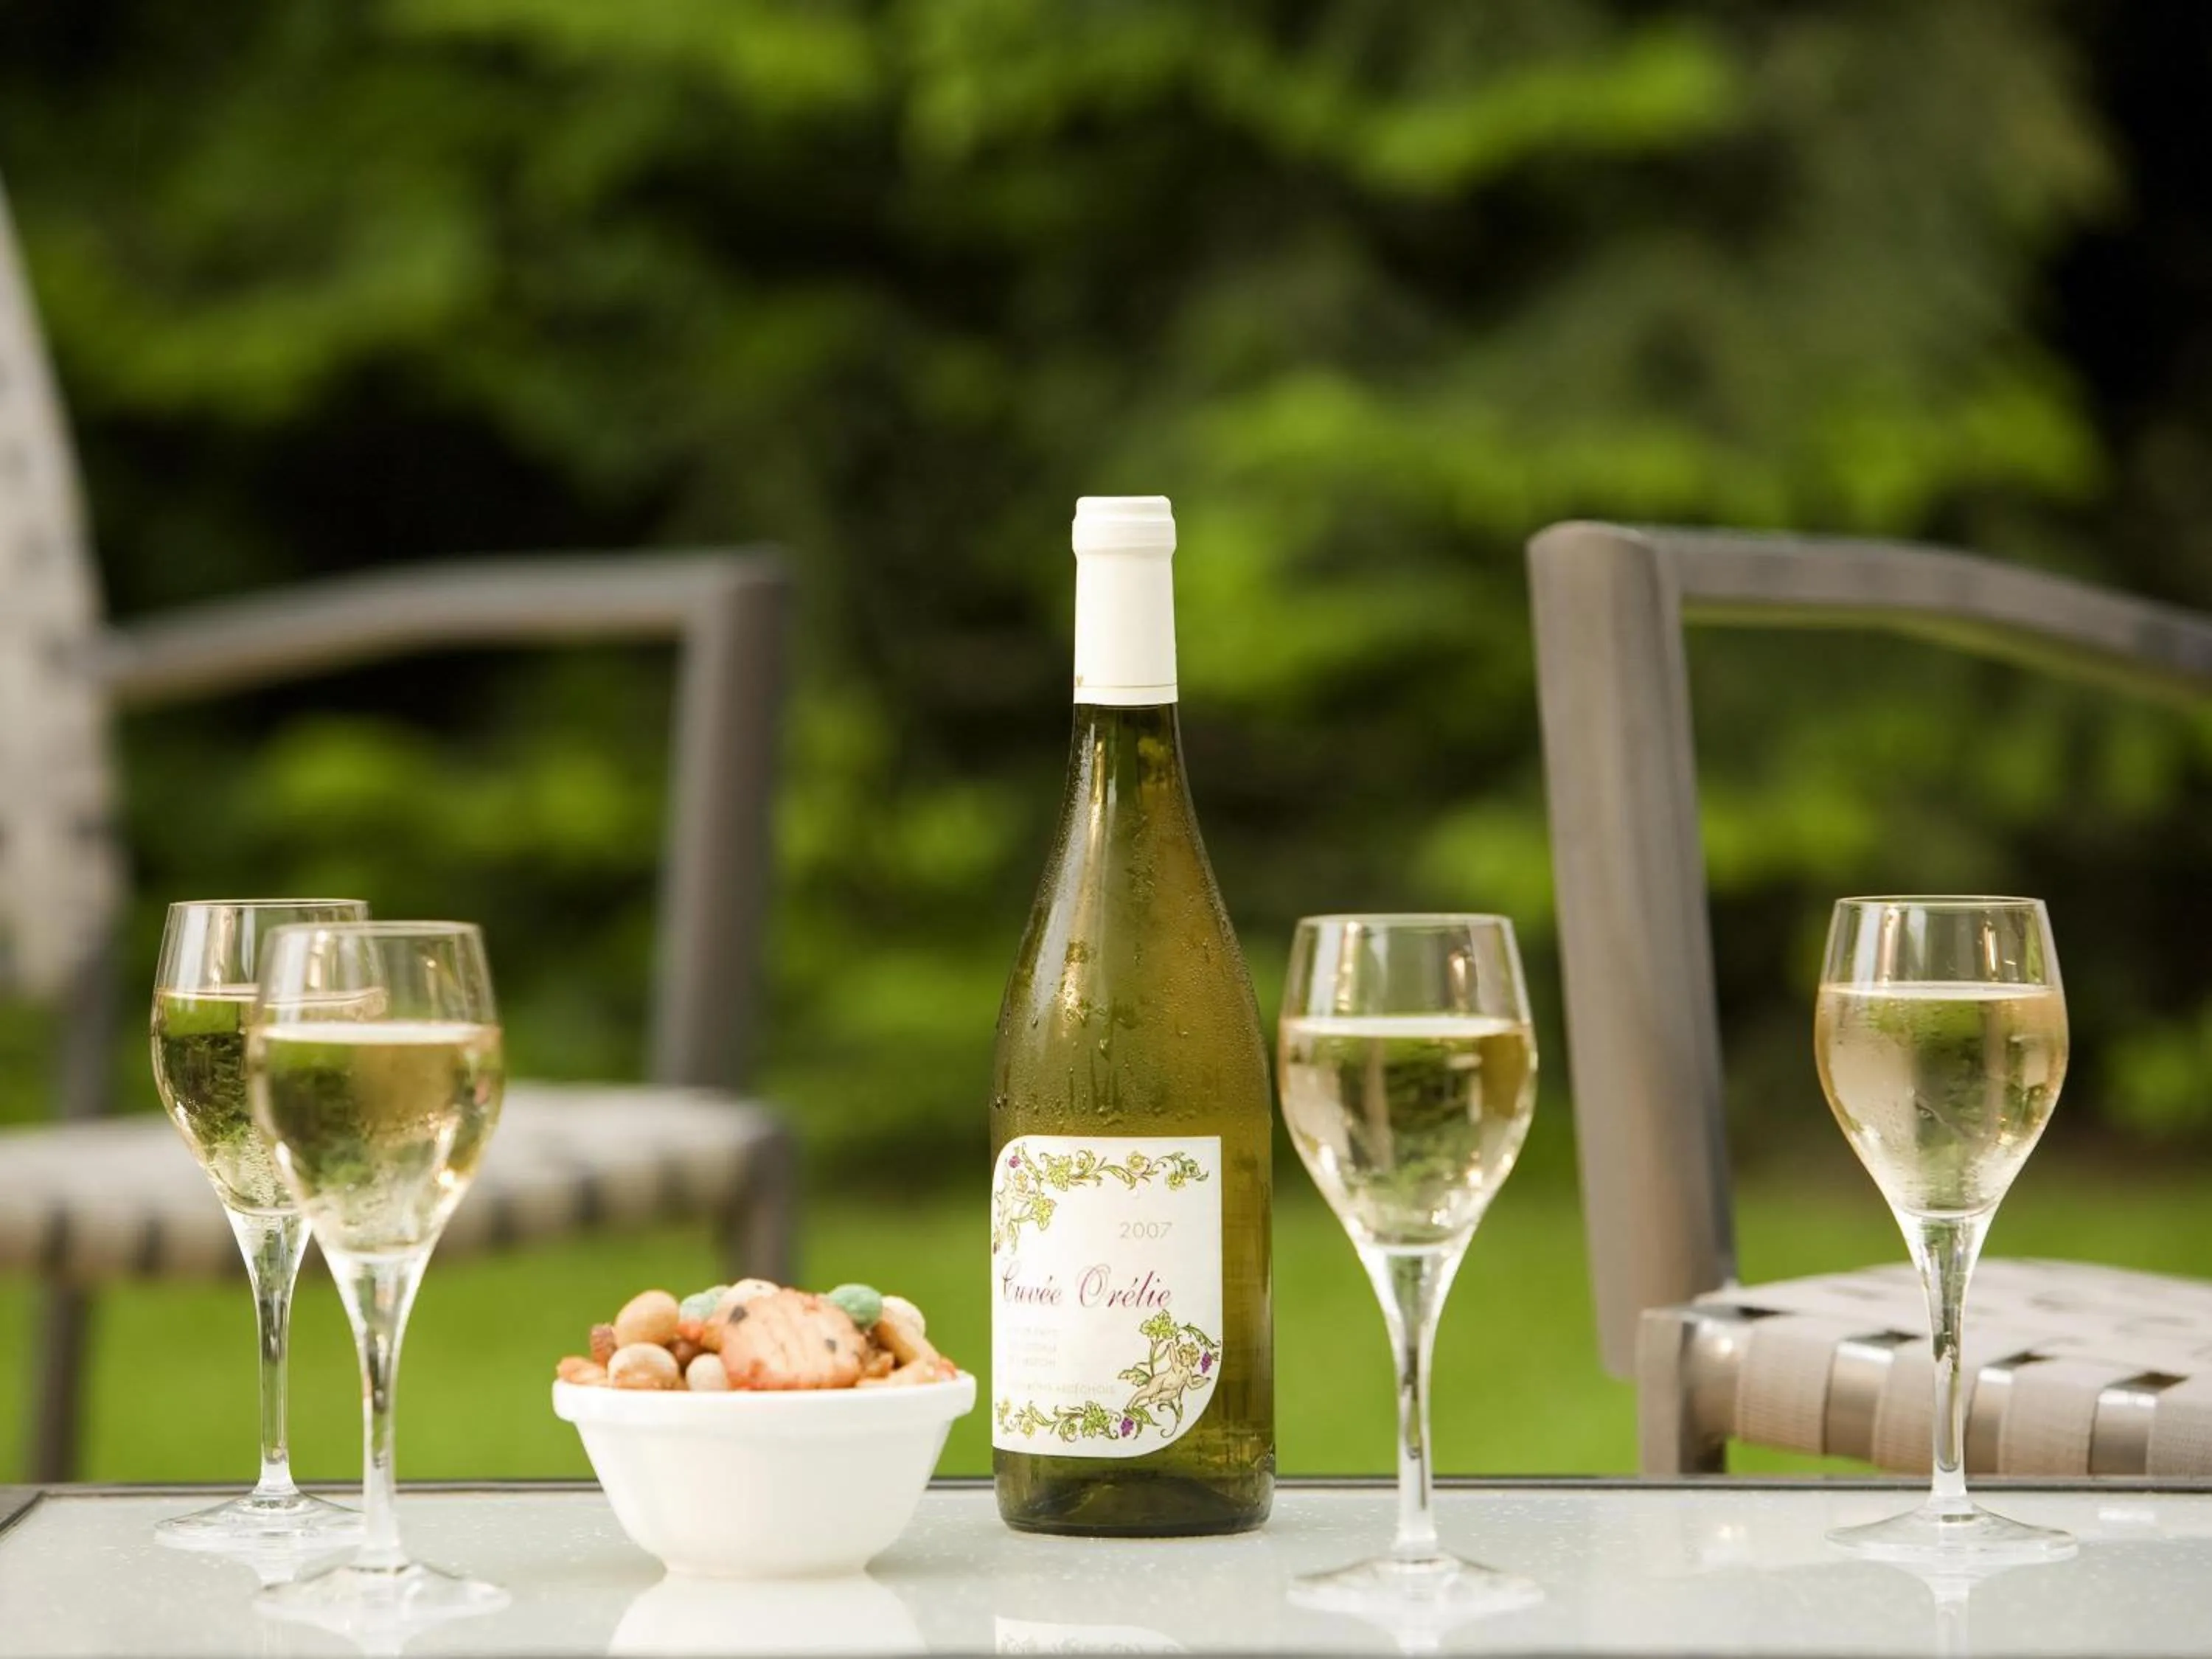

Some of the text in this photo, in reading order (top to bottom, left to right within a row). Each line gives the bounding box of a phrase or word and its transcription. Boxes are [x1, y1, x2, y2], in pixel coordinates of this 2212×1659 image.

[1119, 1221, 1172, 1239] 2007
[1001, 1257, 1174, 1309] Cuvée Orélie
